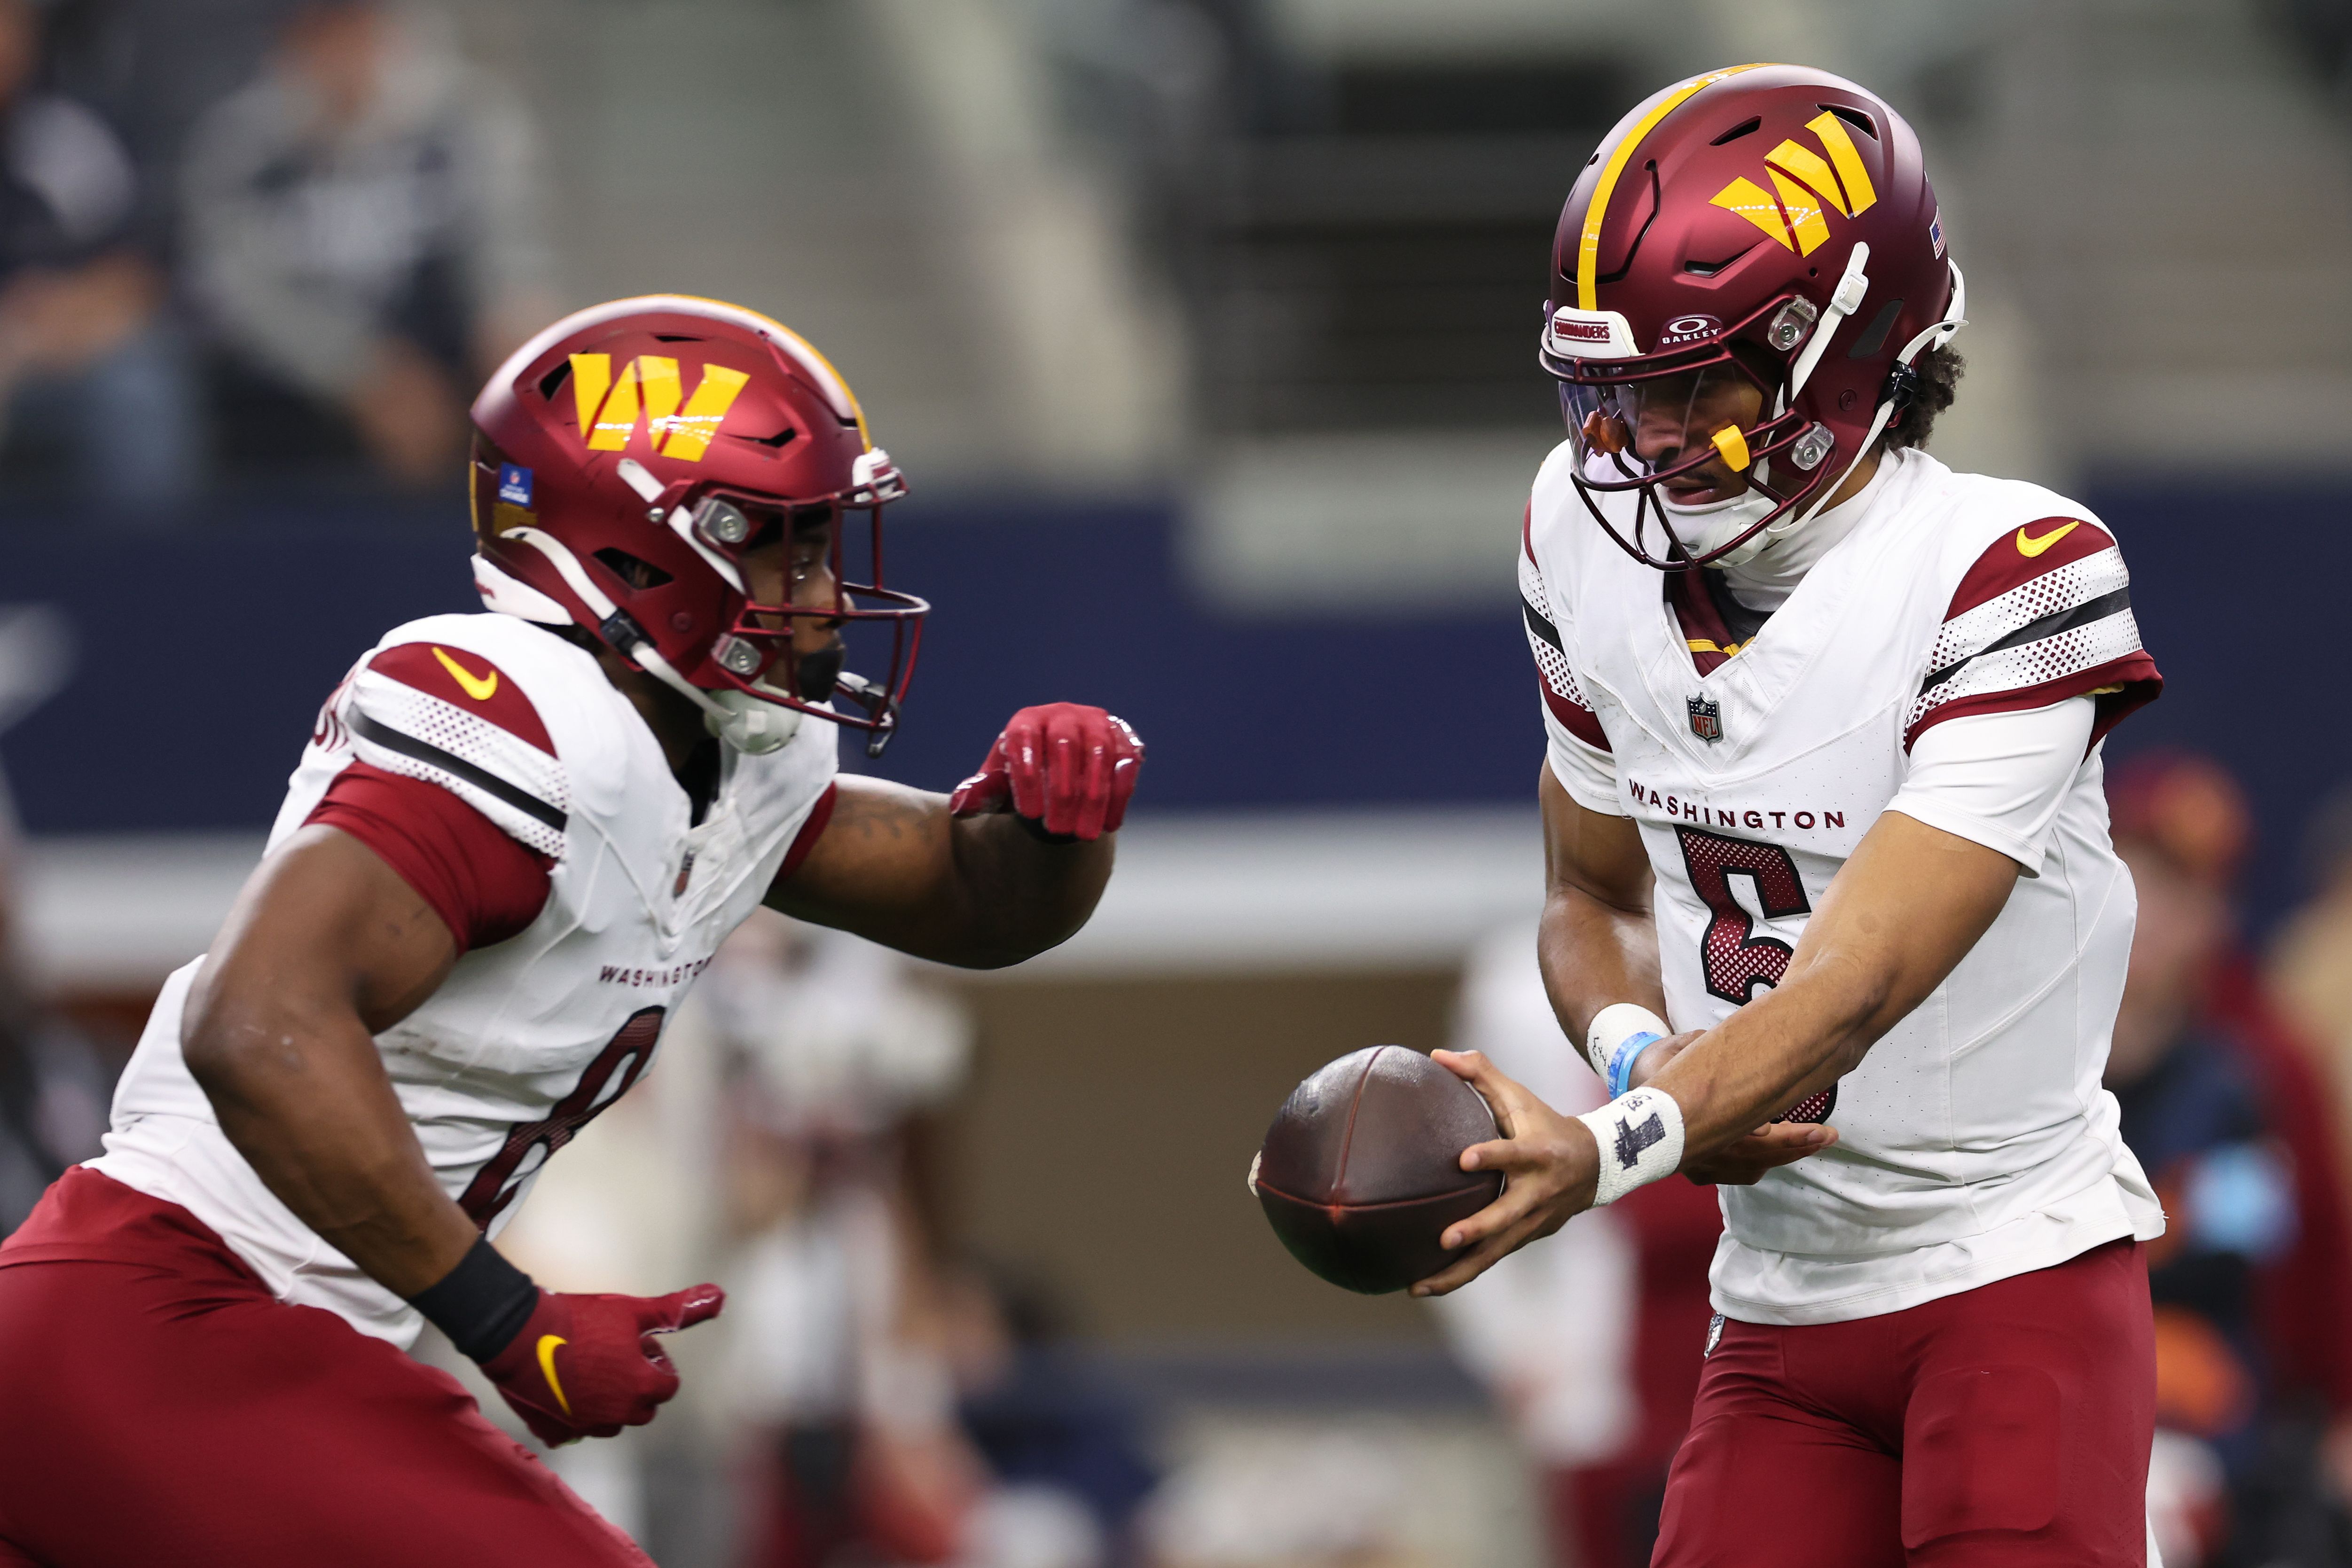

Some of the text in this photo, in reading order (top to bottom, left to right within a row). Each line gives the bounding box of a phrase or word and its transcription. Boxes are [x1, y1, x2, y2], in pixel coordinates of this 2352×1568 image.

[1554, 321, 1610, 339] COMMANDERS
[1662, 328, 1718, 345] OAKLEY
[1693, 714, 1717, 737] NFL
[1629, 778, 1845, 829] WASHINGTON
